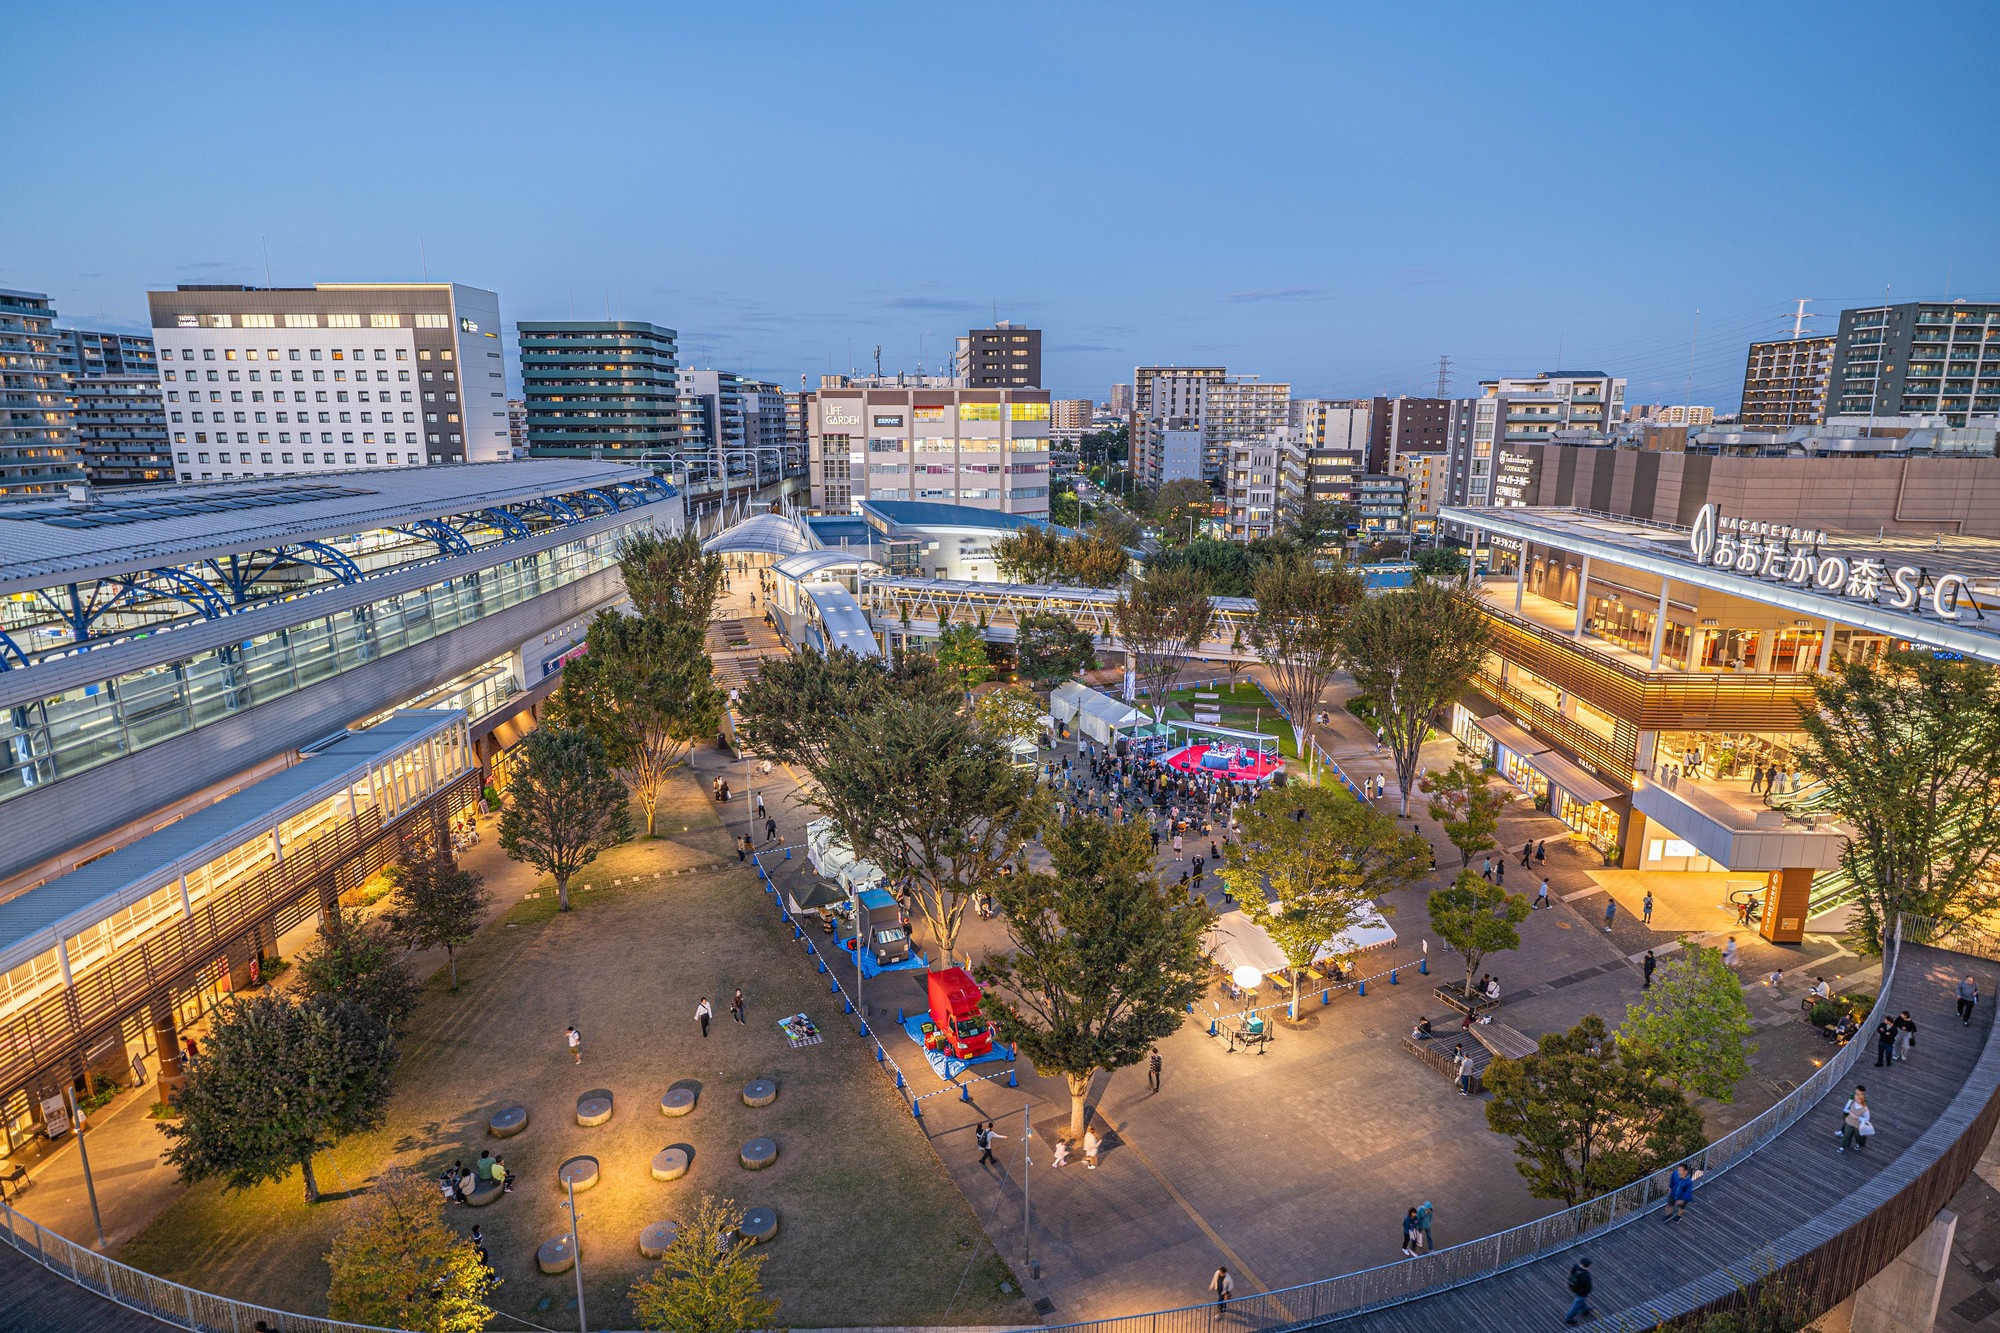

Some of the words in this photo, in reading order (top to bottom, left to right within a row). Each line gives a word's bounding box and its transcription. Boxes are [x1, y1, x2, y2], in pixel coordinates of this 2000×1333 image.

[826, 416, 860, 424] GARDEN
[1720, 516, 1828, 545] NAGAREYAMA
[1714, 534, 1885, 599] おおたかの森
